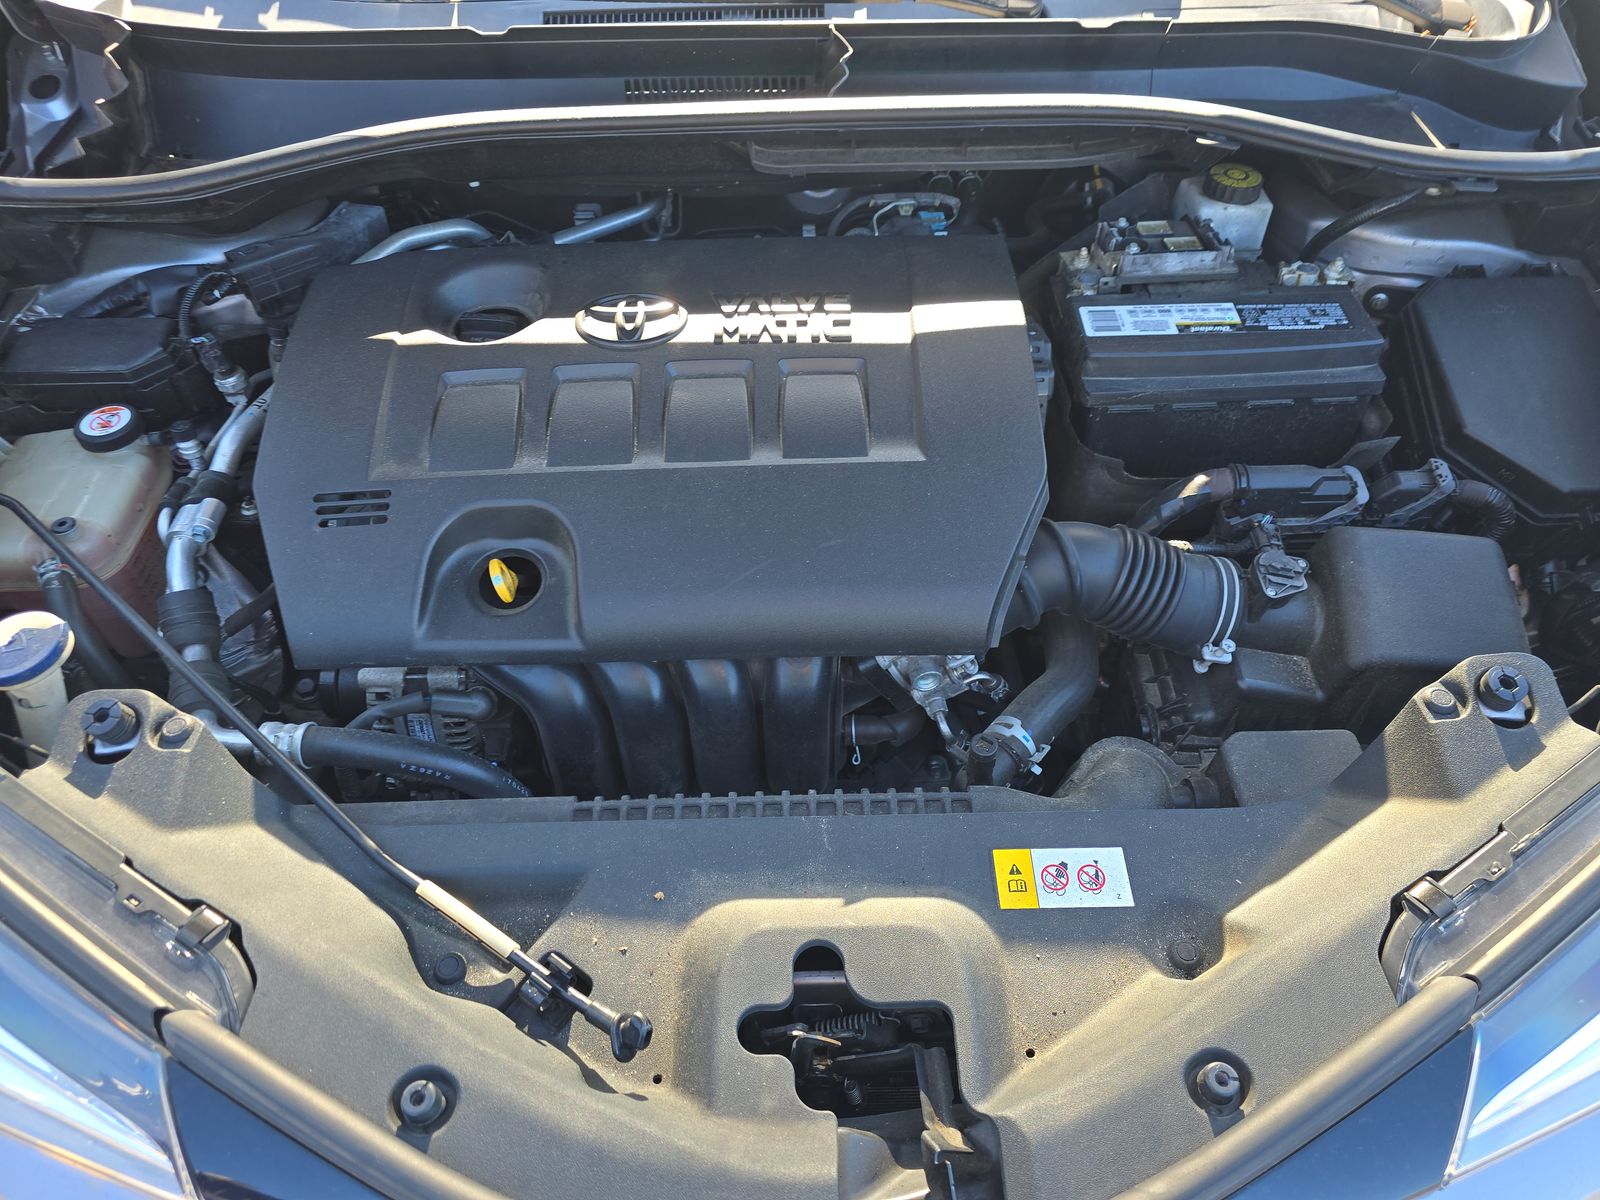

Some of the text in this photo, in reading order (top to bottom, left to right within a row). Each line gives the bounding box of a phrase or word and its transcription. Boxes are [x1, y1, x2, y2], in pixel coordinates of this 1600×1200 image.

[713, 293, 852, 315] VALVE
[713, 313, 852, 344] MATIC
[1190, 325, 1233, 333] Duralast
